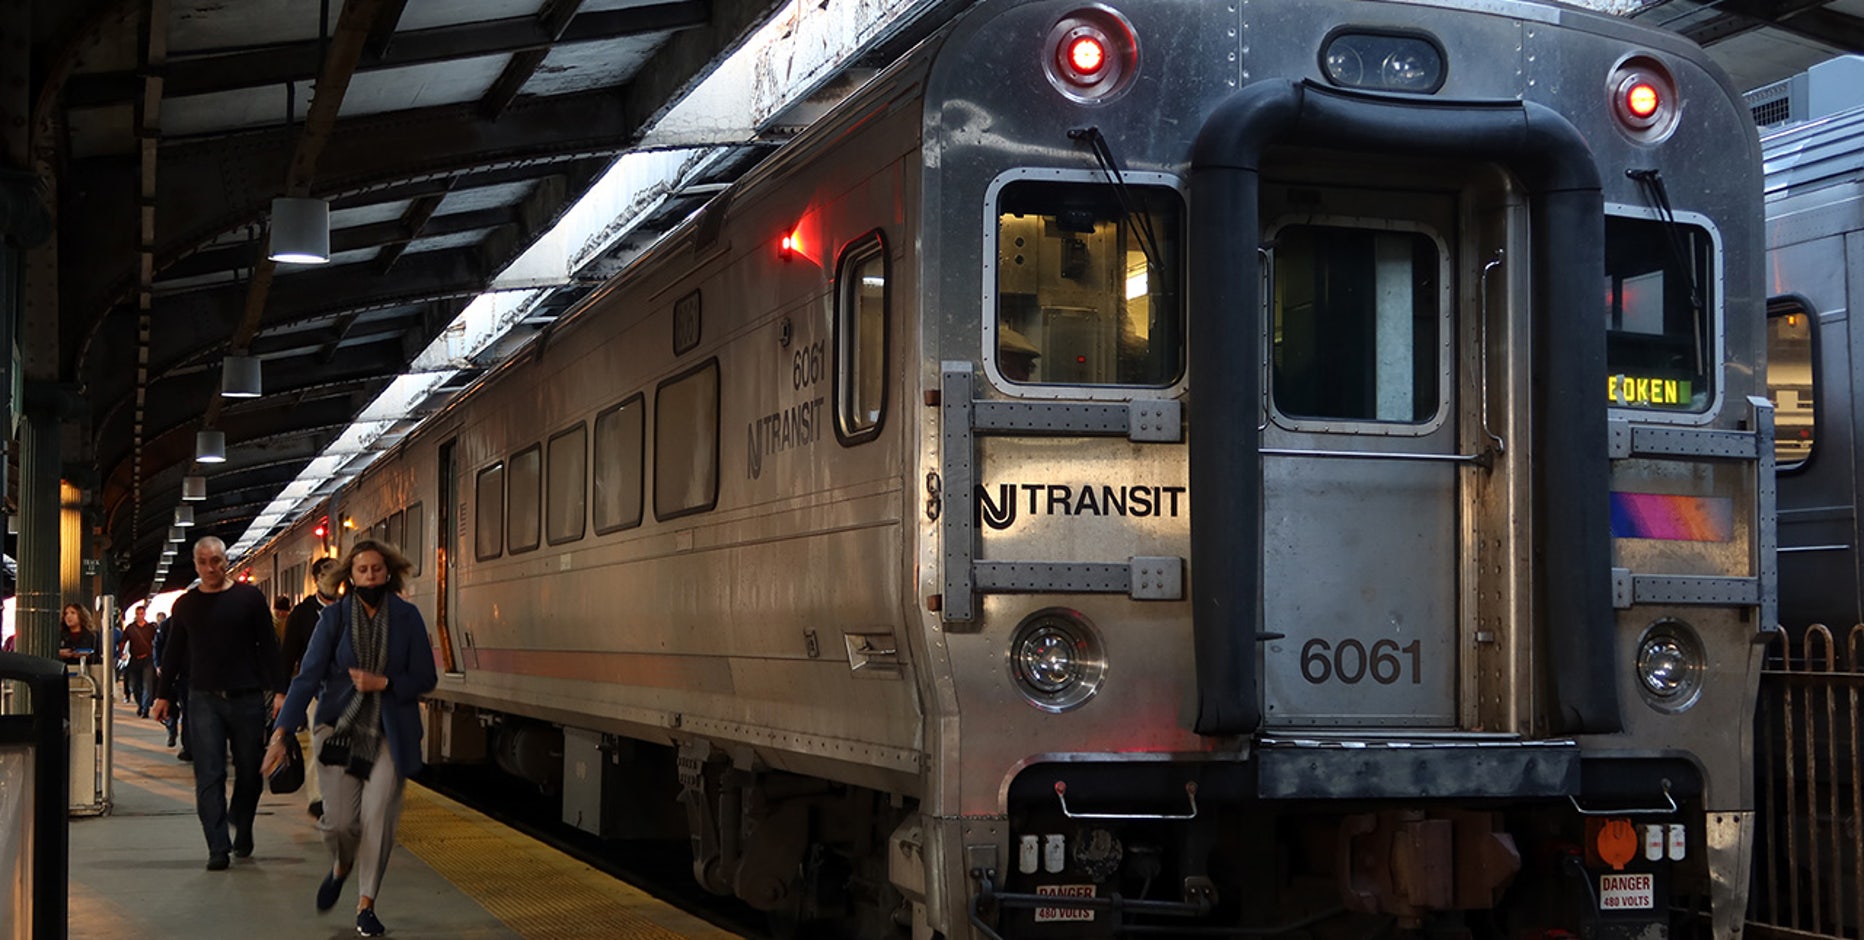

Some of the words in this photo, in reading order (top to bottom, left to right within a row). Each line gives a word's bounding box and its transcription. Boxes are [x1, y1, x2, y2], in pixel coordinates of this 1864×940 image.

[793, 339, 825, 391] 6061
[764, 397, 824, 456] TRANSIT
[974, 484, 1017, 530] NJ
[1021, 484, 1186, 517] TRANSIT
[1301, 638, 1421, 685] 6061
[1603, 876, 1650, 891] DANGER
[1604, 897, 1619, 907] 480
[1622, 896, 1649, 907] VOLTS
[1039, 908, 1056, 918] 480
[1060, 908, 1090, 918] VOLTS
